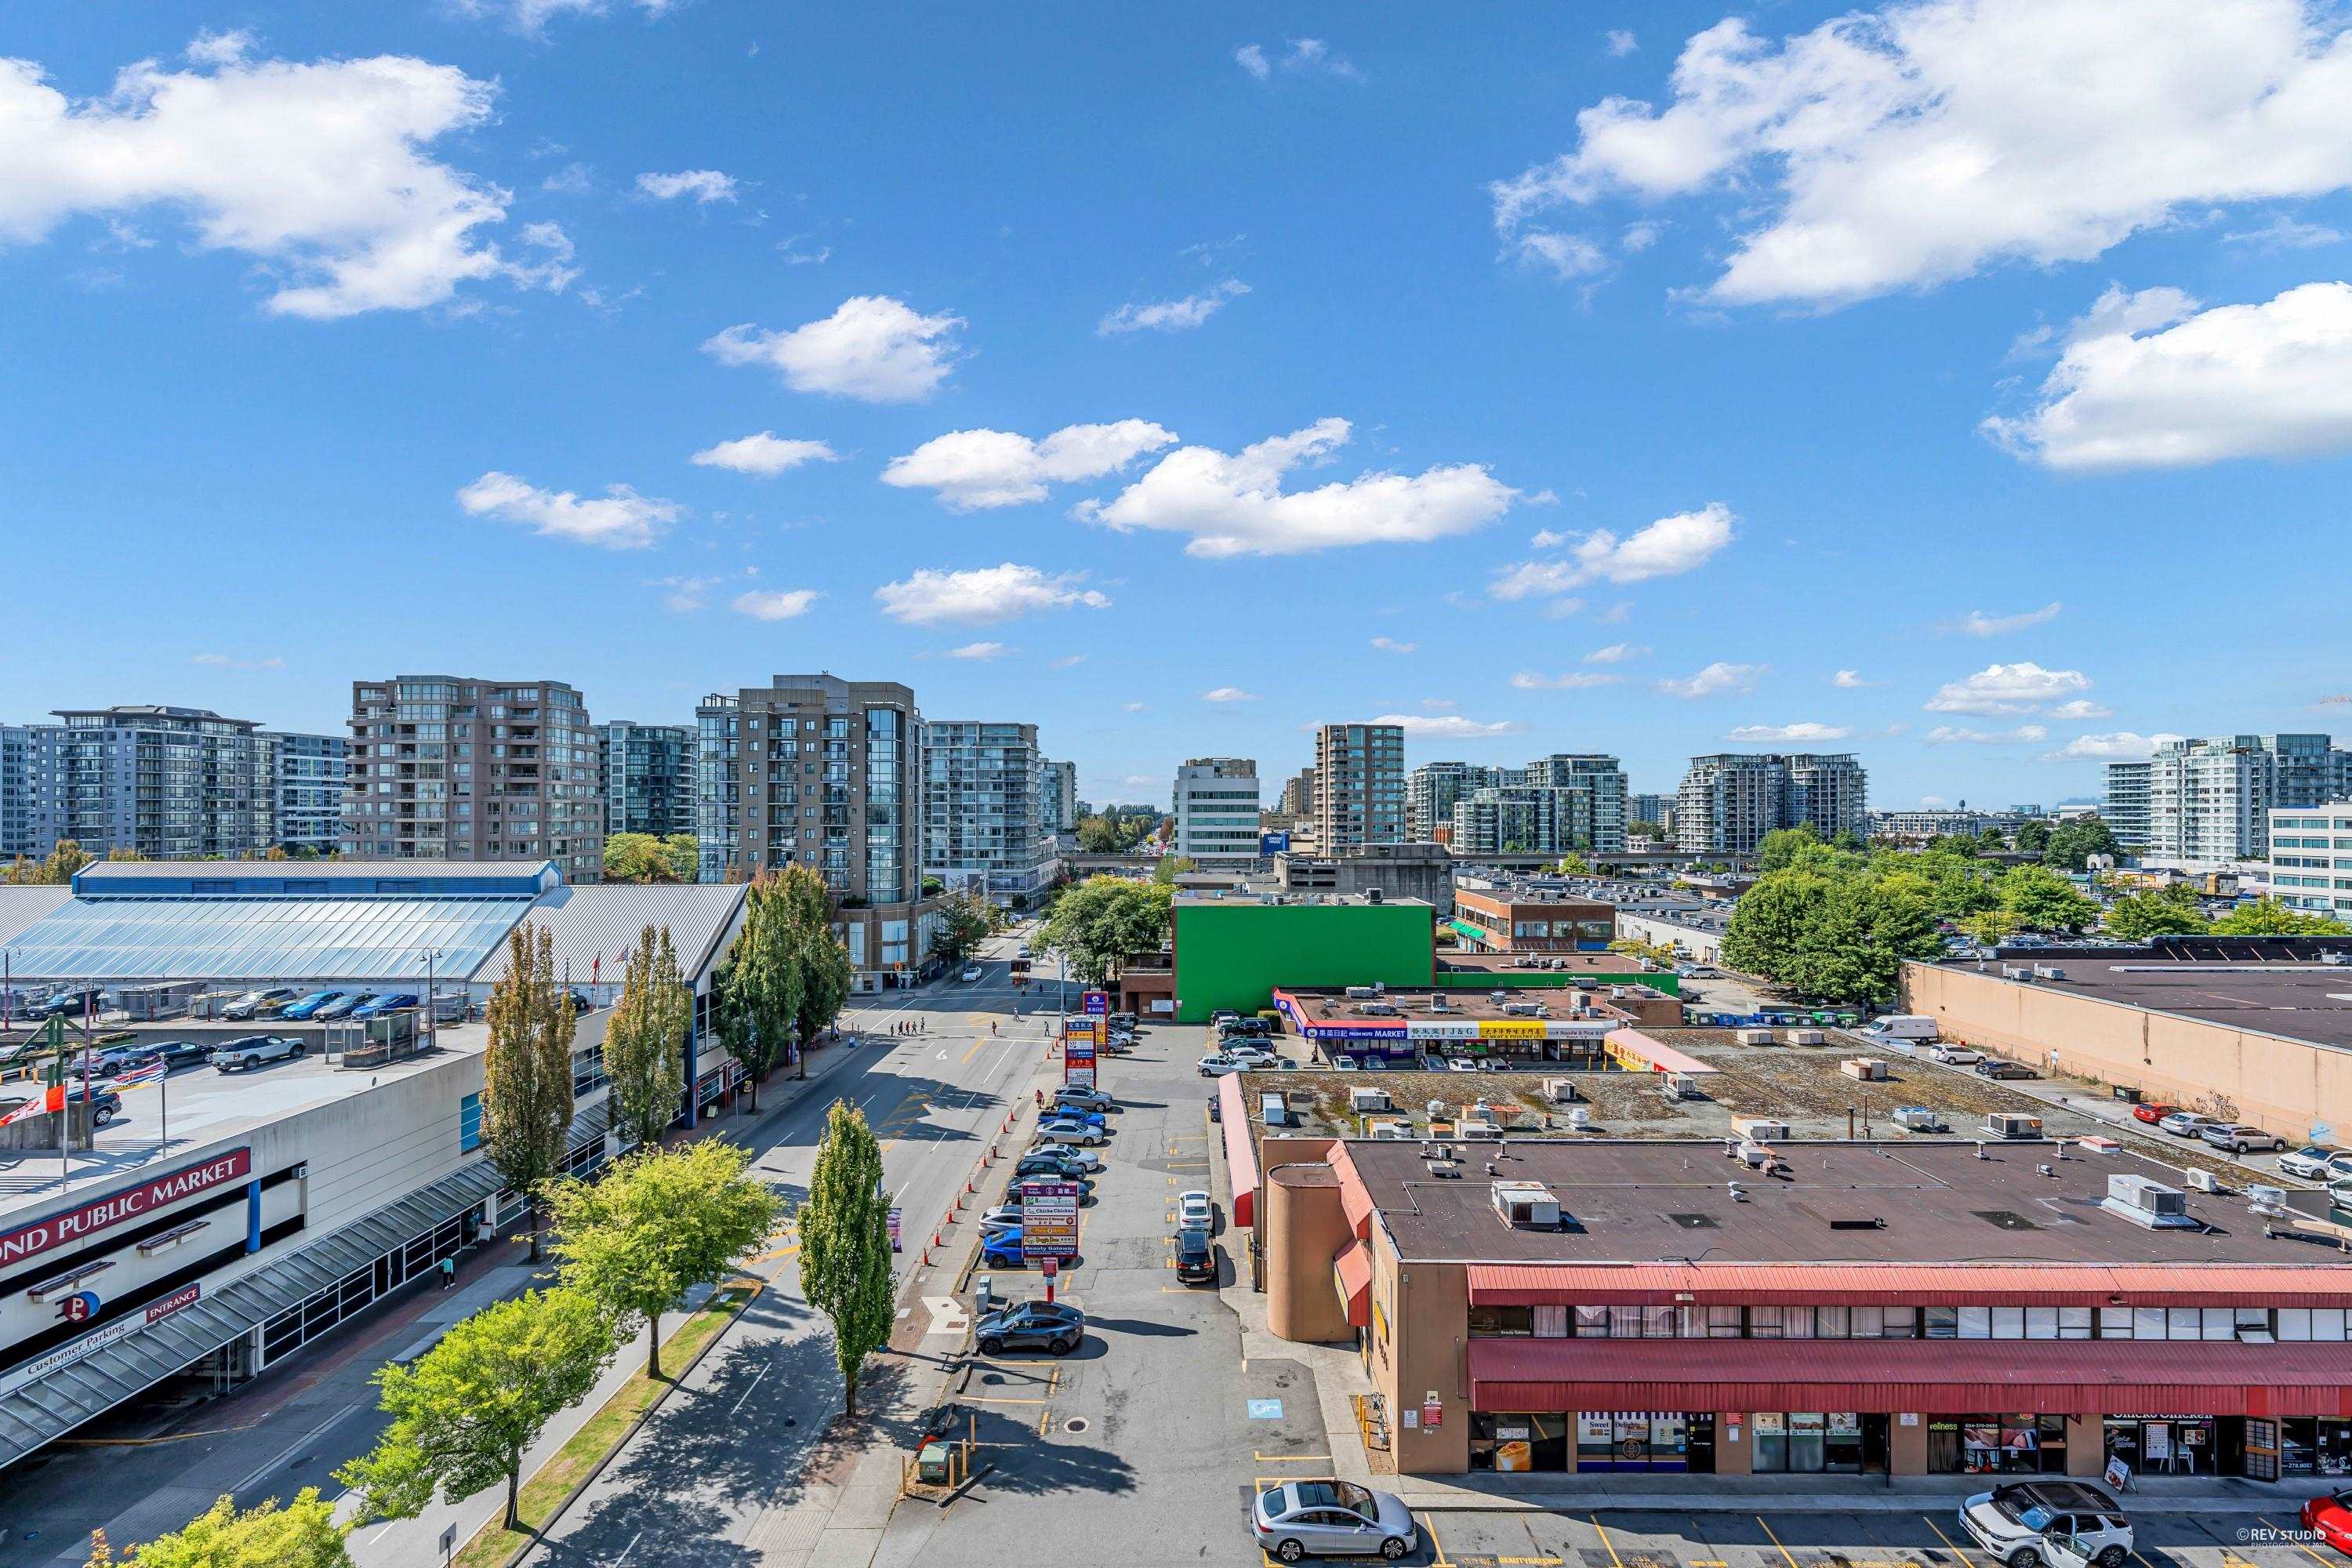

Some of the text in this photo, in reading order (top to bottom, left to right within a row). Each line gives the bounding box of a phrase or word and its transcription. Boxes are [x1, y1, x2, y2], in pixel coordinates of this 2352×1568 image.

[59, 1192, 143, 1239] PUBLIC
[151, 1157, 237, 1204] MARKET
[72, 1298, 84, 1313] P
[150, 1289, 198, 1318] ENTRANCE
[27, 1323, 125, 1374] Customer Parking
